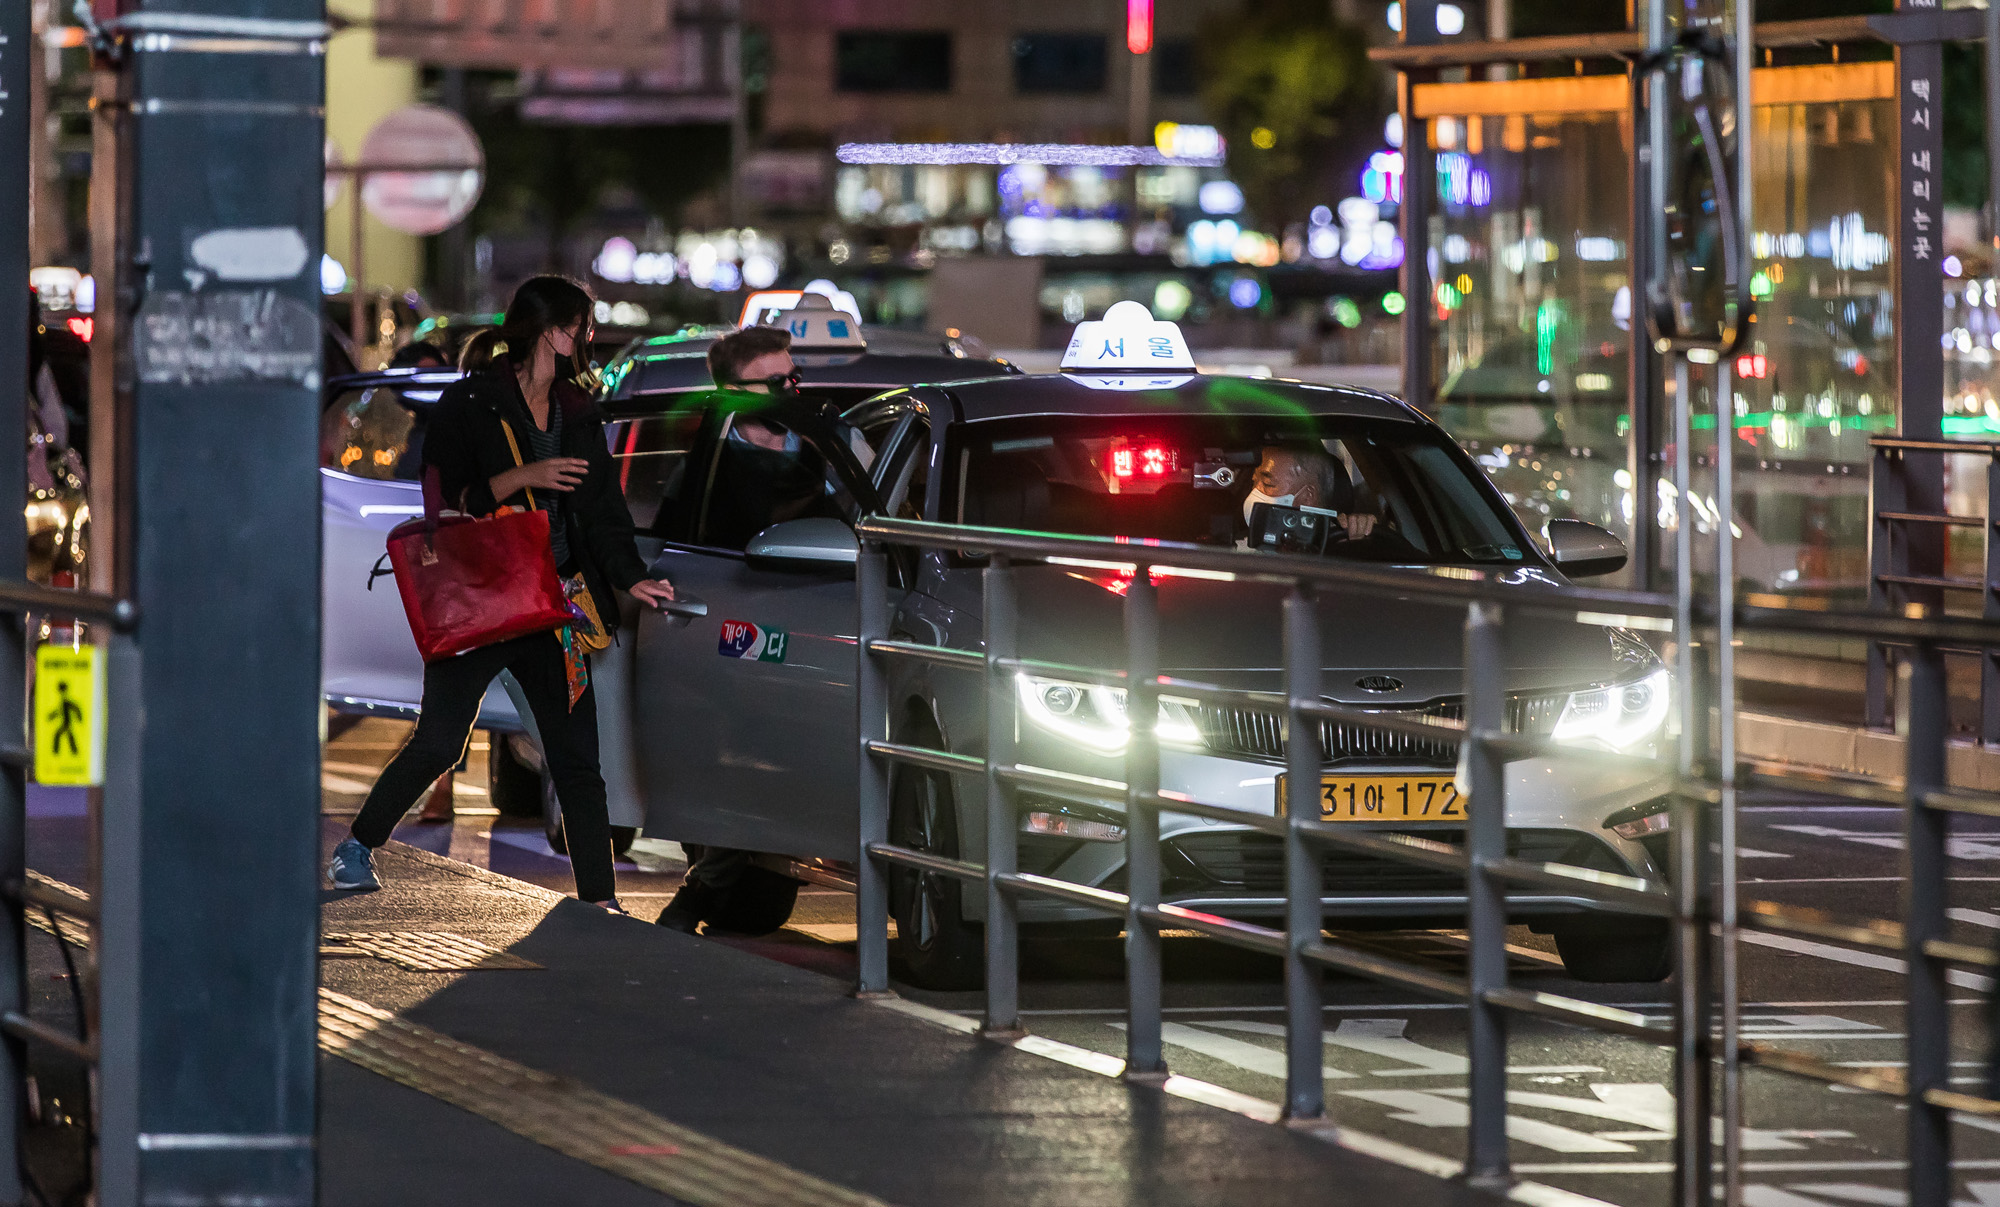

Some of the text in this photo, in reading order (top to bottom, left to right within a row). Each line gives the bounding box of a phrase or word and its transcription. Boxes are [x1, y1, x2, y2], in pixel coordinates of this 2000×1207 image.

[1911, 79, 1930, 131] 택시
[1098, 337, 1175, 360] 서울
[724, 623, 747, 651] 개인
[1362, 677, 1397, 689] KIA
[1396, 782, 1469, 816] 172
